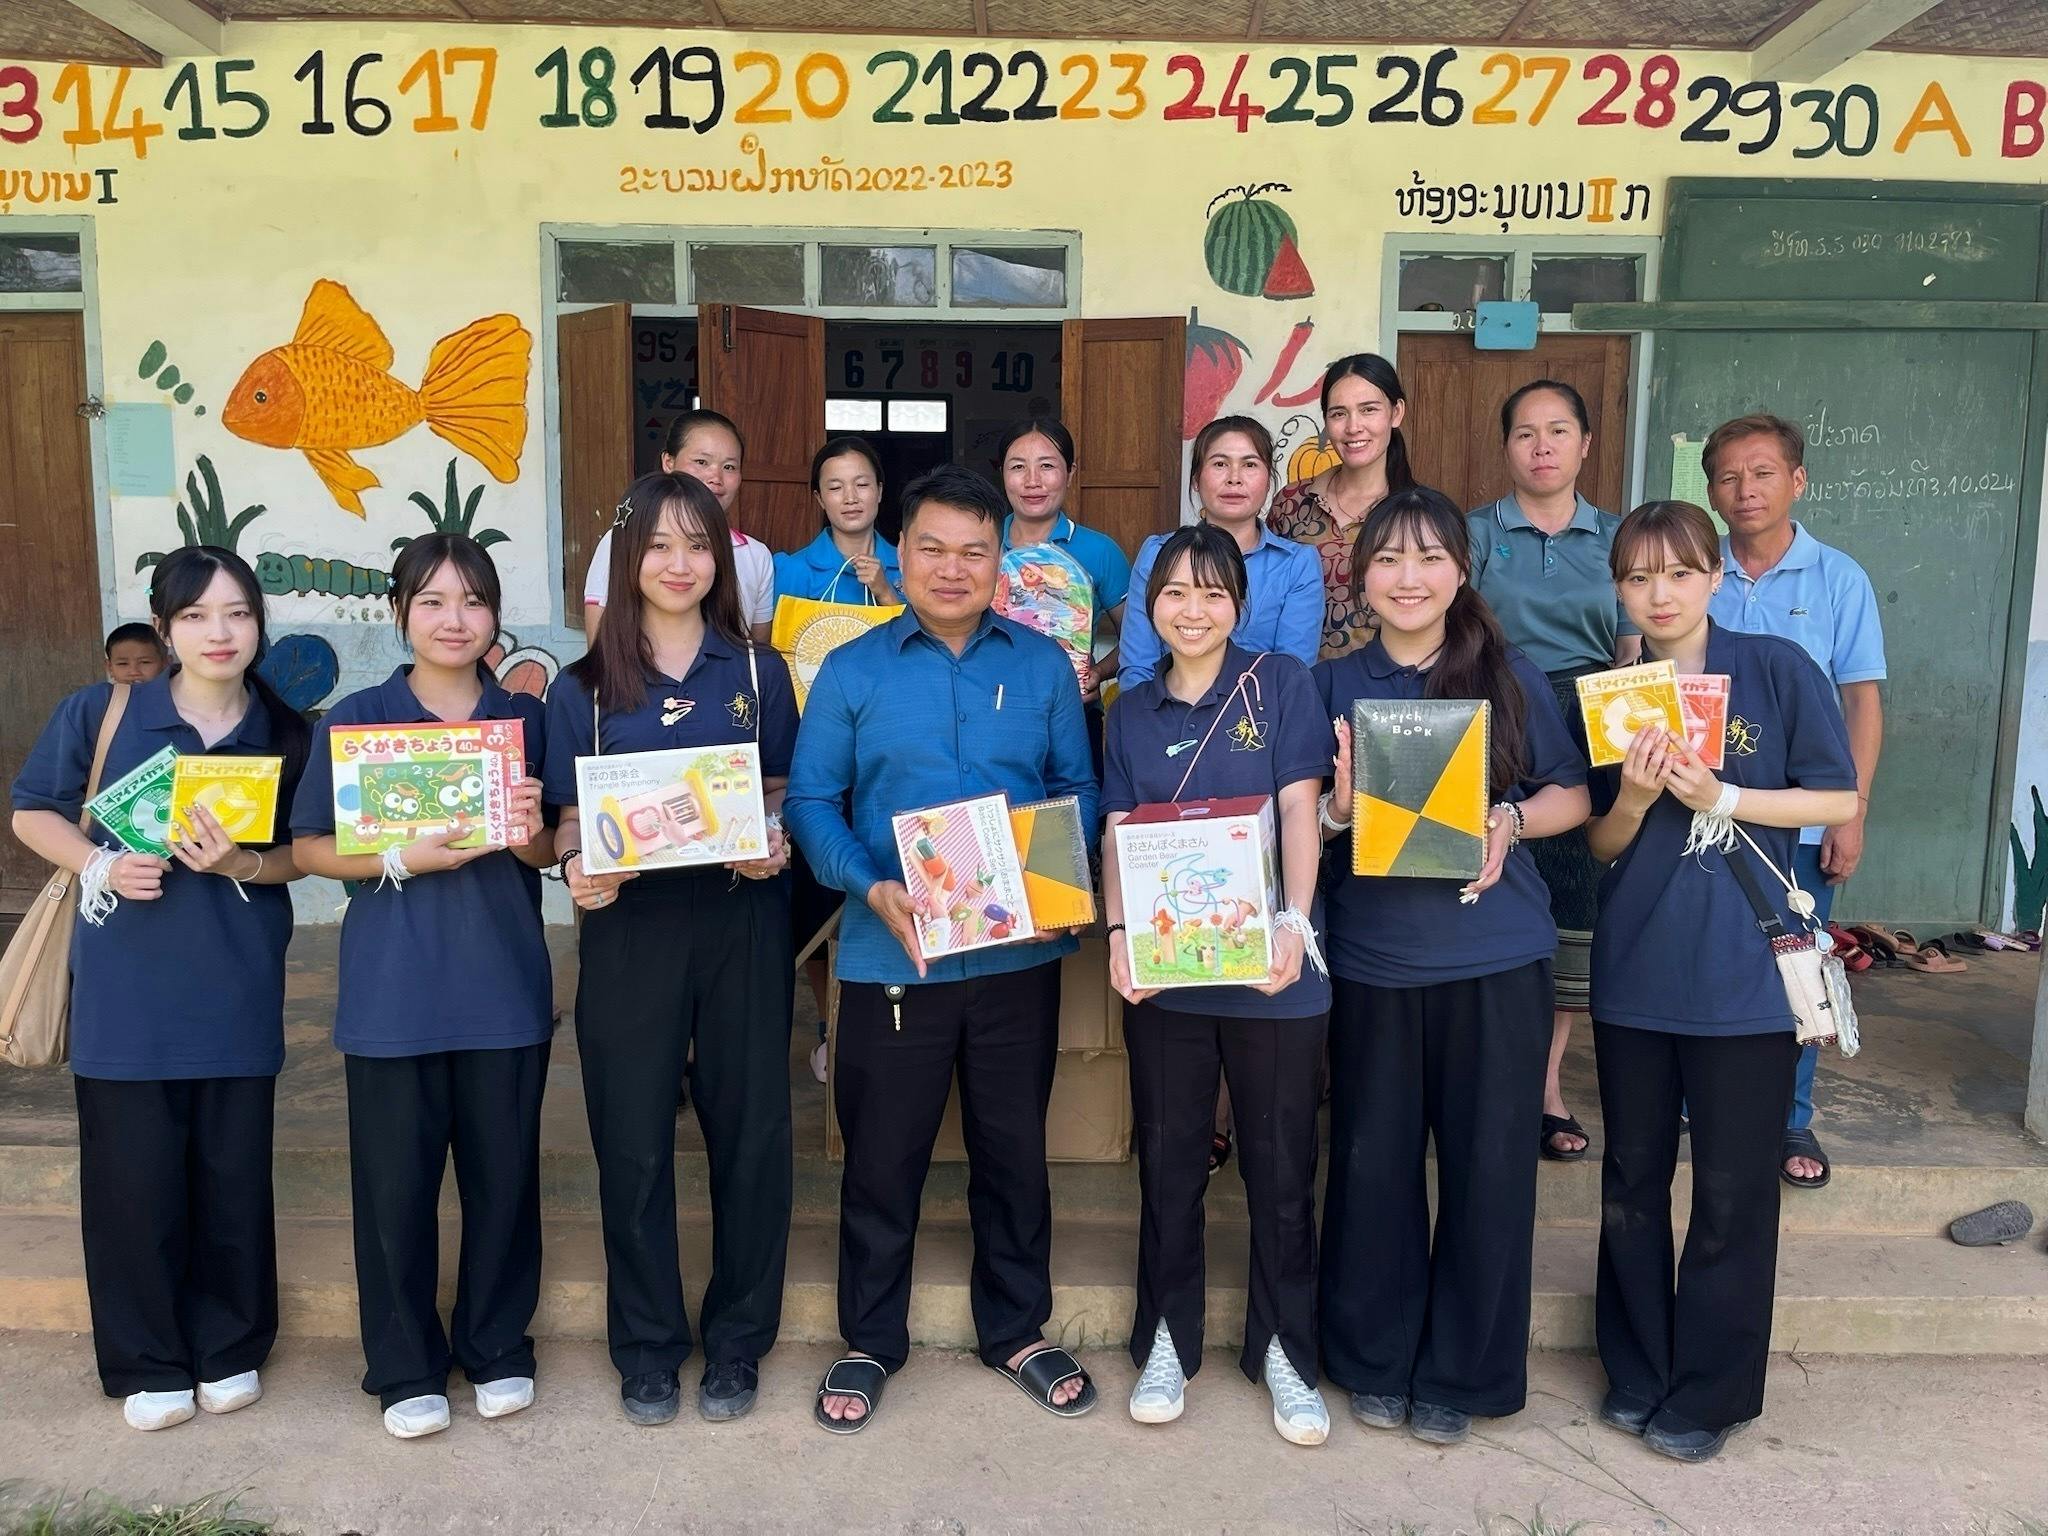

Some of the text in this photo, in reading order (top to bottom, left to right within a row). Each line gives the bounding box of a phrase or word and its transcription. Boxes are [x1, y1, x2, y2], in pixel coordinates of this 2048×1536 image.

[53, 63, 164, 160] 14
[163, 59, 270, 141] 15
[294, 49, 391, 137] 16
[398, 47, 498, 133] 17
[535, 46, 617, 128] 18
[630, 46, 725, 134] 19
[734, 50, 850, 124] 20
[867, 49, 961, 124] 21
[960, 50, 1058, 122] 22
[1060, 53, 1149, 120] 23
[1163, 54, 1265, 133] 24
[1264, 53, 1358, 127] 25
[1368, 47, 1464, 127] 26
[1472, 53, 1571, 127] 27
[1577, 54, 1681, 128] 28
[1680, 76, 1782, 155] 29
[1790, 84, 1879, 158] 30
[1894, 81, 1972, 158] A
[2001, 80, 2047, 158] B
[95, 168, 118, 204] I
[1620, 183, 1651, 221] ກ
[844, 350, 864, 388] 6
[881, 350, 904, 390] 7
[920, 349, 940, 389] 8
[955, 350, 973, 388] 9
[991, 351, 1034, 393] 10
[343, 735, 454, 755] らくがきちょう
[588, 768, 640, 782] 森の音楽会
[621, 778, 661, 789] Symphony
[489, 769, 500, 841] らくがきちょう
[1127, 853, 1158, 863] Garden
